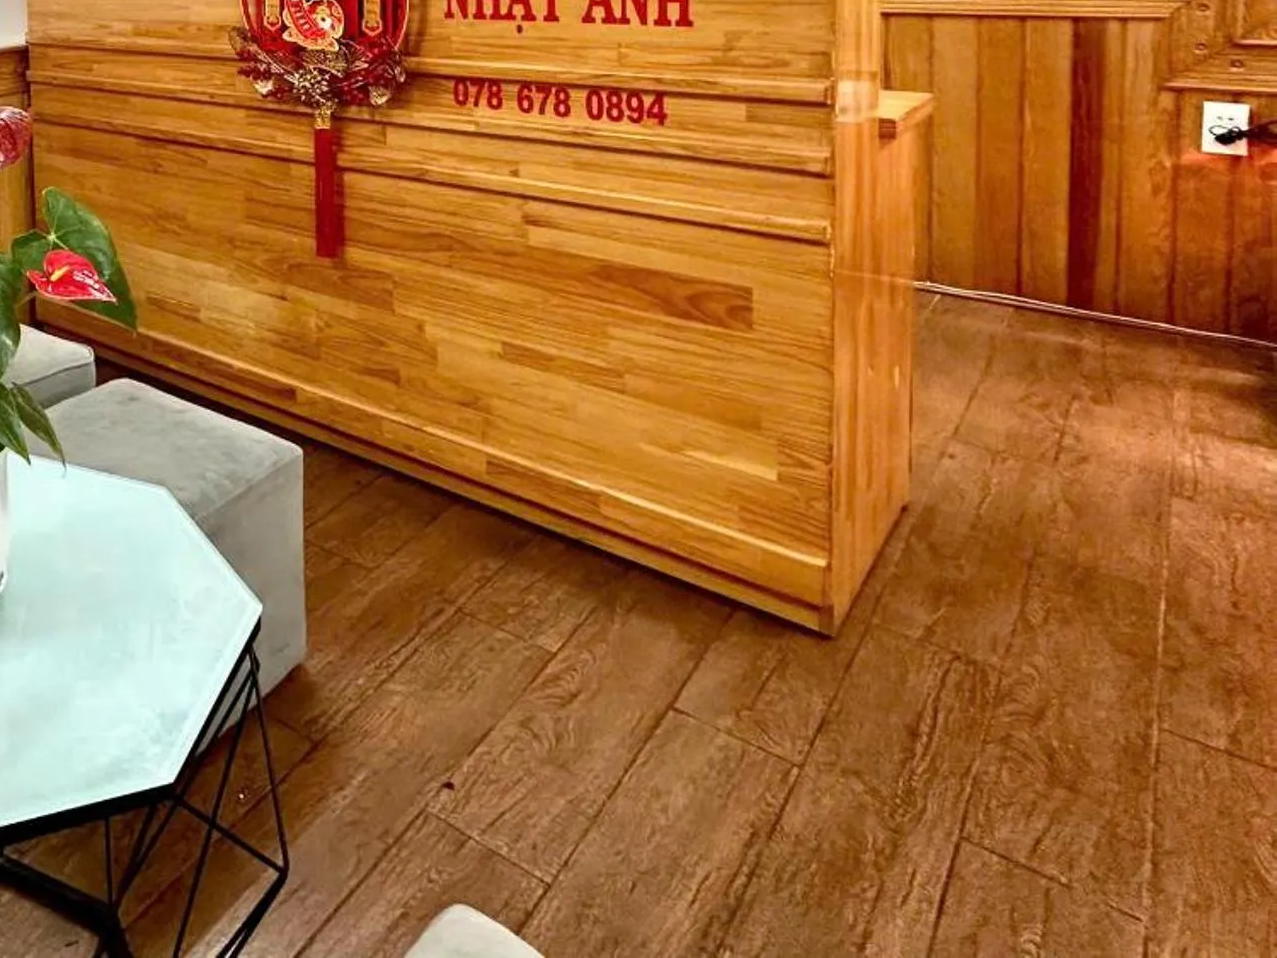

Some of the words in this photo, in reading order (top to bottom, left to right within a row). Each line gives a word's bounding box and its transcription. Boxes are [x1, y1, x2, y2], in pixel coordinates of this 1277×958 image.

[452, 77, 503, 110] 078
[516, 83, 571, 118] 678
[584, 88, 668, 127] 0894
